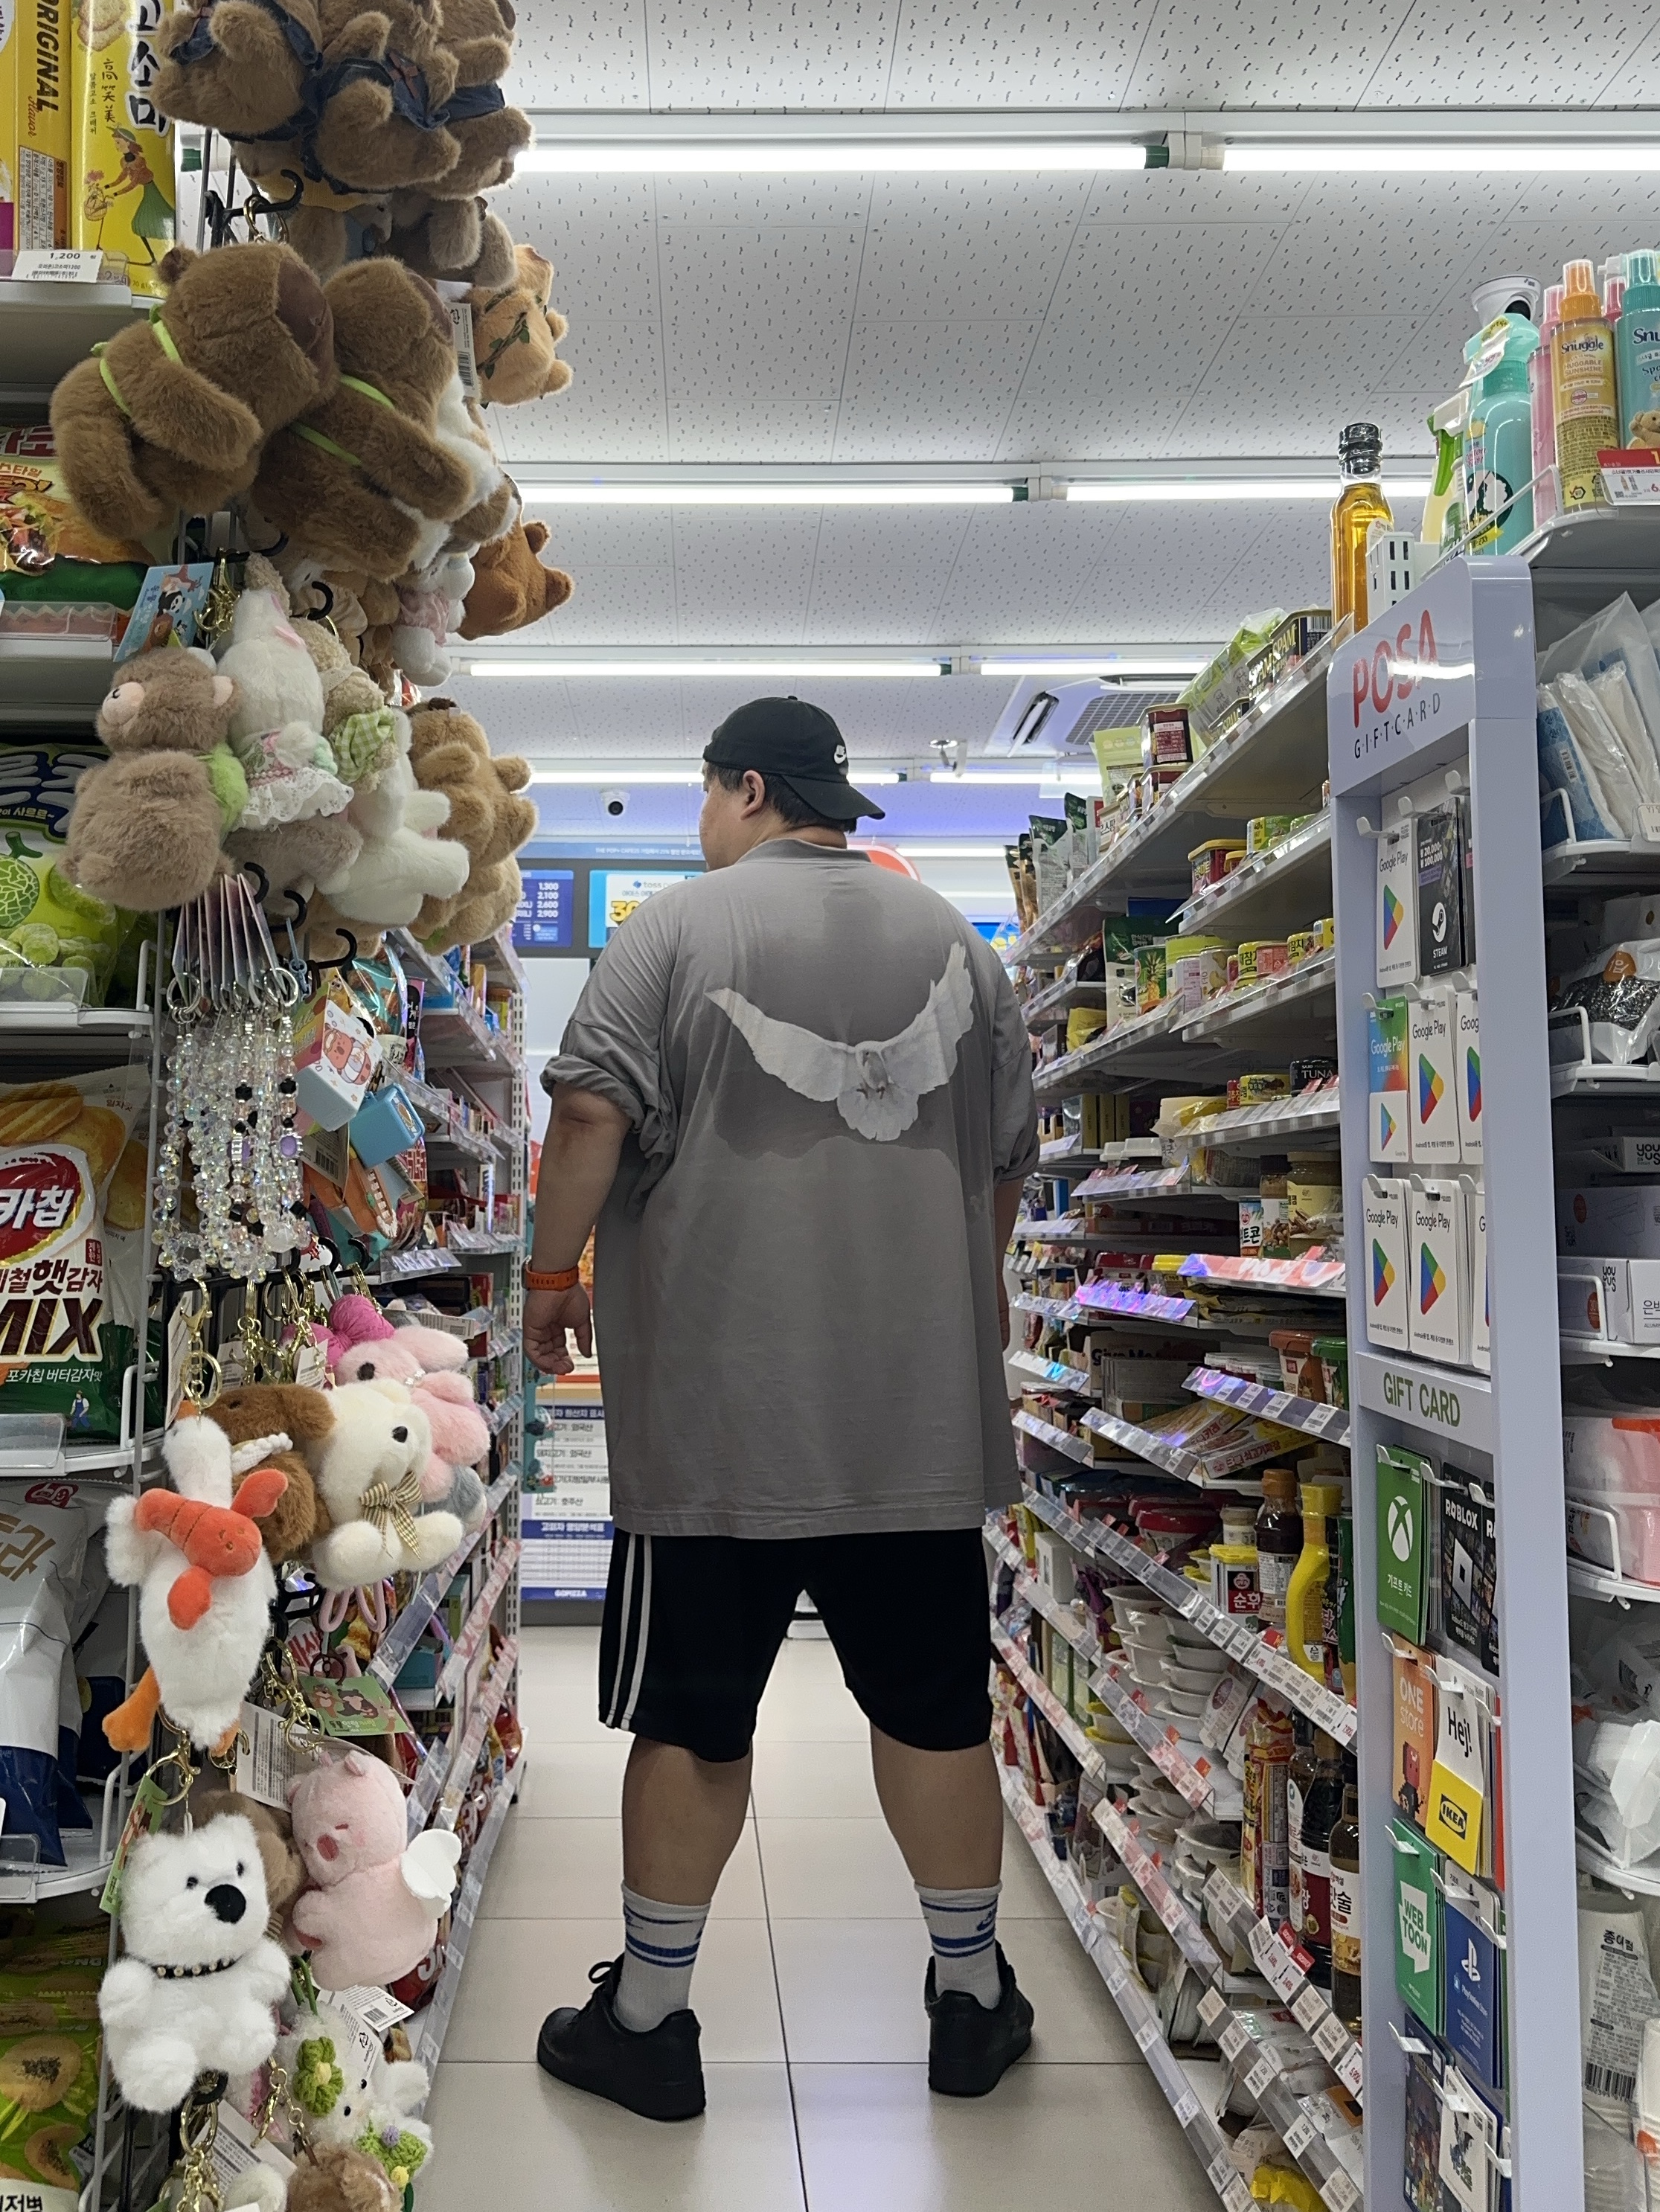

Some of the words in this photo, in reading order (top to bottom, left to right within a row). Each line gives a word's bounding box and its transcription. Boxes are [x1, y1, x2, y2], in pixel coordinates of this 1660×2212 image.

[129, 0, 167, 132] 고소미
[1561, 335, 1603, 354] Snuggle
[1564, 359, 1602, 370] HUGGABLE
[1564, 367, 1602, 375] SUNSHINE
[1272, 623, 1296, 660] SPAM
[1353, 609, 1438, 728] POSA
[1379, 855, 1396, 873] Google
[1397, 850, 1409, 866] Play
[1432, 946, 1448, 959] STEAM
[1412, 1024, 1432, 1041] Google
[1435, 1019, 1446, 1037] Play
[1371, 1038, 1391, 1057] Google
[1392, 1036, 1406, 1054] Play
[1301, 1070, 1334, 1079] TUNA
[1366, 1208, 1385, 1228] Google
[1386, 1211, 1399, 1229] Play
[1415, 1210, 1437, 1231] Google
[1438, 1212, 1451, 1233] Play
[0, 1298, 103, 1355] MIX
[6, 1368, 45, 1383] 포카칩
[46, 1368, 103, 1383] 버터감자맛
[1383, 1371, 1413, 1411] GIFT
[1419, 1383, 1461, 1428] CARD
[1445, 1498, 1478, 1531] ROBLOX
[1233, 1591, 1261, 1610] 순후
[1400, 1676, 1424, 1714] ONE
[1400, 1705, 1425, 1738] store
[1447, 1706, 1473, 1758] Hej!
[1441, 1803, 1465, 1829] IKEA
[1404, 1903, 1425, 1933] WEB
[1403, 1915, 1428, 1955] TOON
